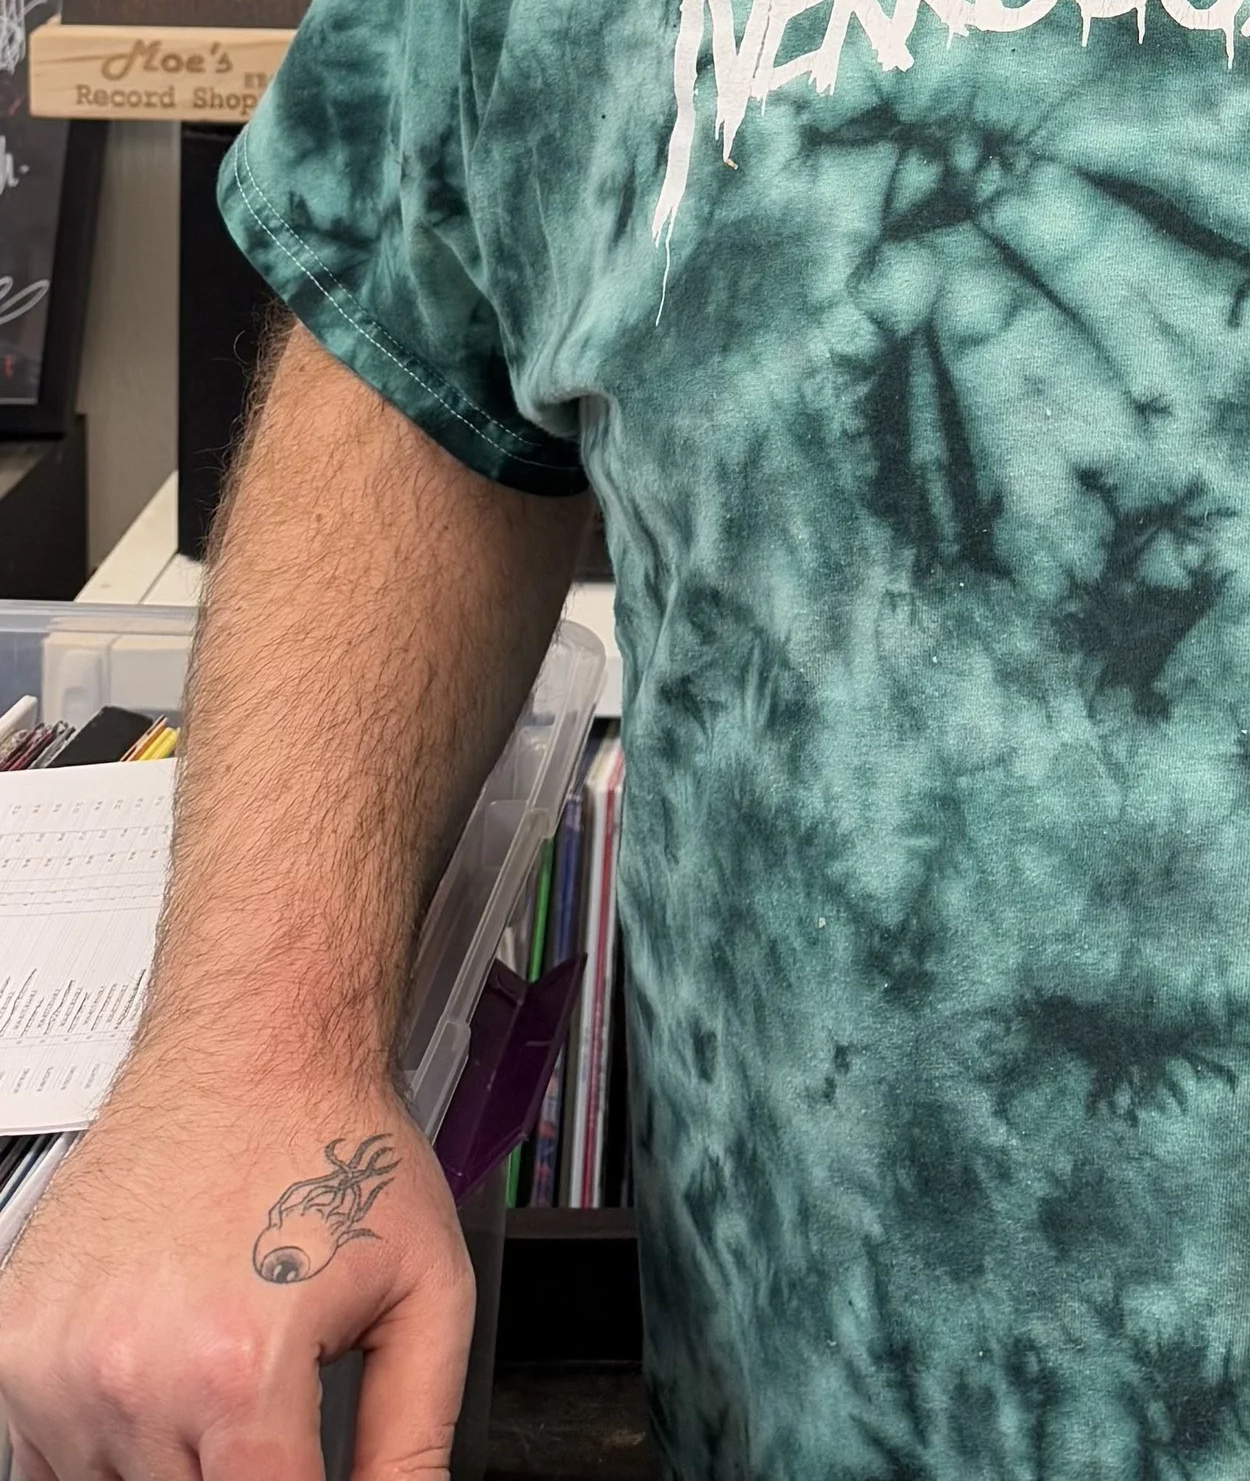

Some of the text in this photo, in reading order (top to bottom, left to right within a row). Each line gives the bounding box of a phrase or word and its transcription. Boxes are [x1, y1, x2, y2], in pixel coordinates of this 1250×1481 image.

[101, 38, 234, 82] Moe's
[75, 83, 259, 116] Record Shop
